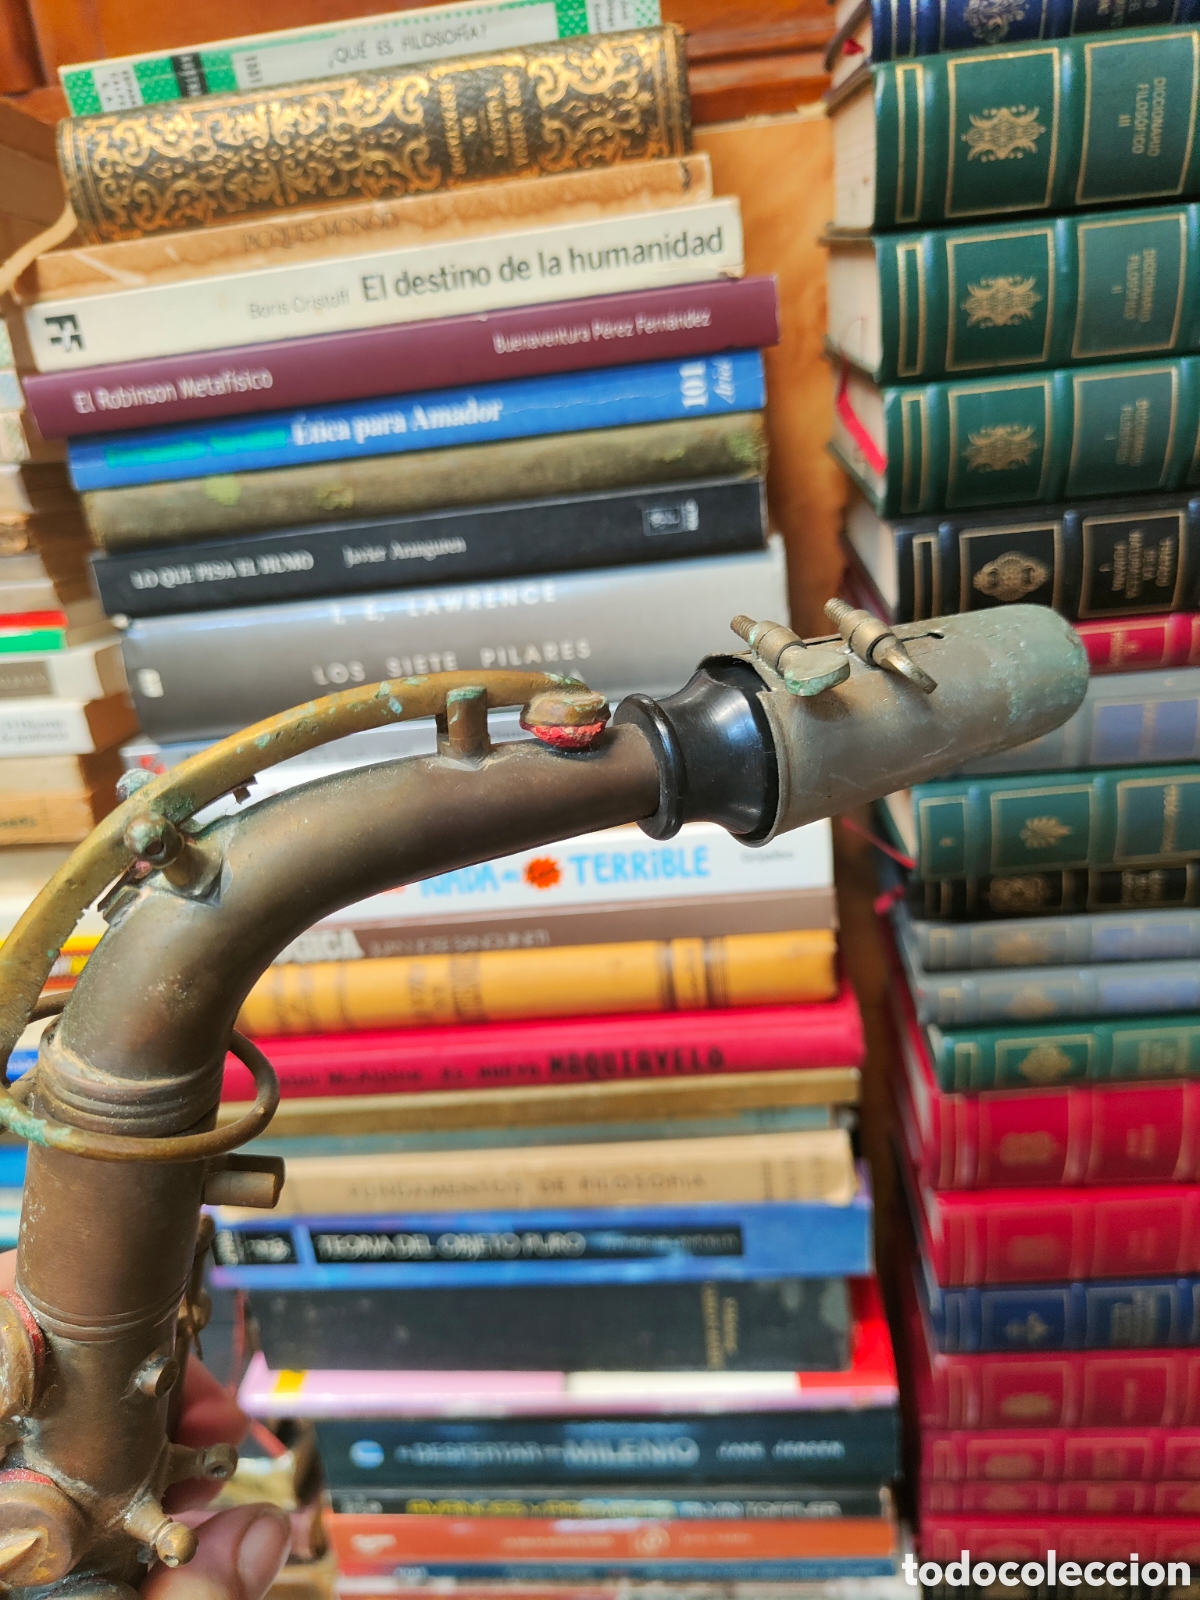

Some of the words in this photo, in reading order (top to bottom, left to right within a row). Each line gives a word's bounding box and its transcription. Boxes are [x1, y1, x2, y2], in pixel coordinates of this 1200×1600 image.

[376, 38, 394, 57] ES
[179, 55, 203, 97] AUSTRA
[439, 84, 467, 174] ESPECTADOR
[487, 100, 508, 157] GASSET
[1118, 115, 1132, 128] III
[1146, 77, 1167, 158] DICCIONARIO
[362, 272, 389, 301] El
[395, 262, 492, 300] destino
[499, 255, 532, 284] de
[538, 251, 562, 279] la
[568, 227, 724, 272] humanidad
[493, 322, 590, 354] Buenaventura
[73, 391, 96, 413] El
[95, 380, 178, 411] Robinson
[353, 406, 407, 444] para
[411, 396, 503, 431] Amador
[405, 581, 557, 618] LAWRENCE
[311, 659, 366, 686] LOS
[384, 649, 459, 679] SIETE
[478, 637, 592, 669] PILARES
